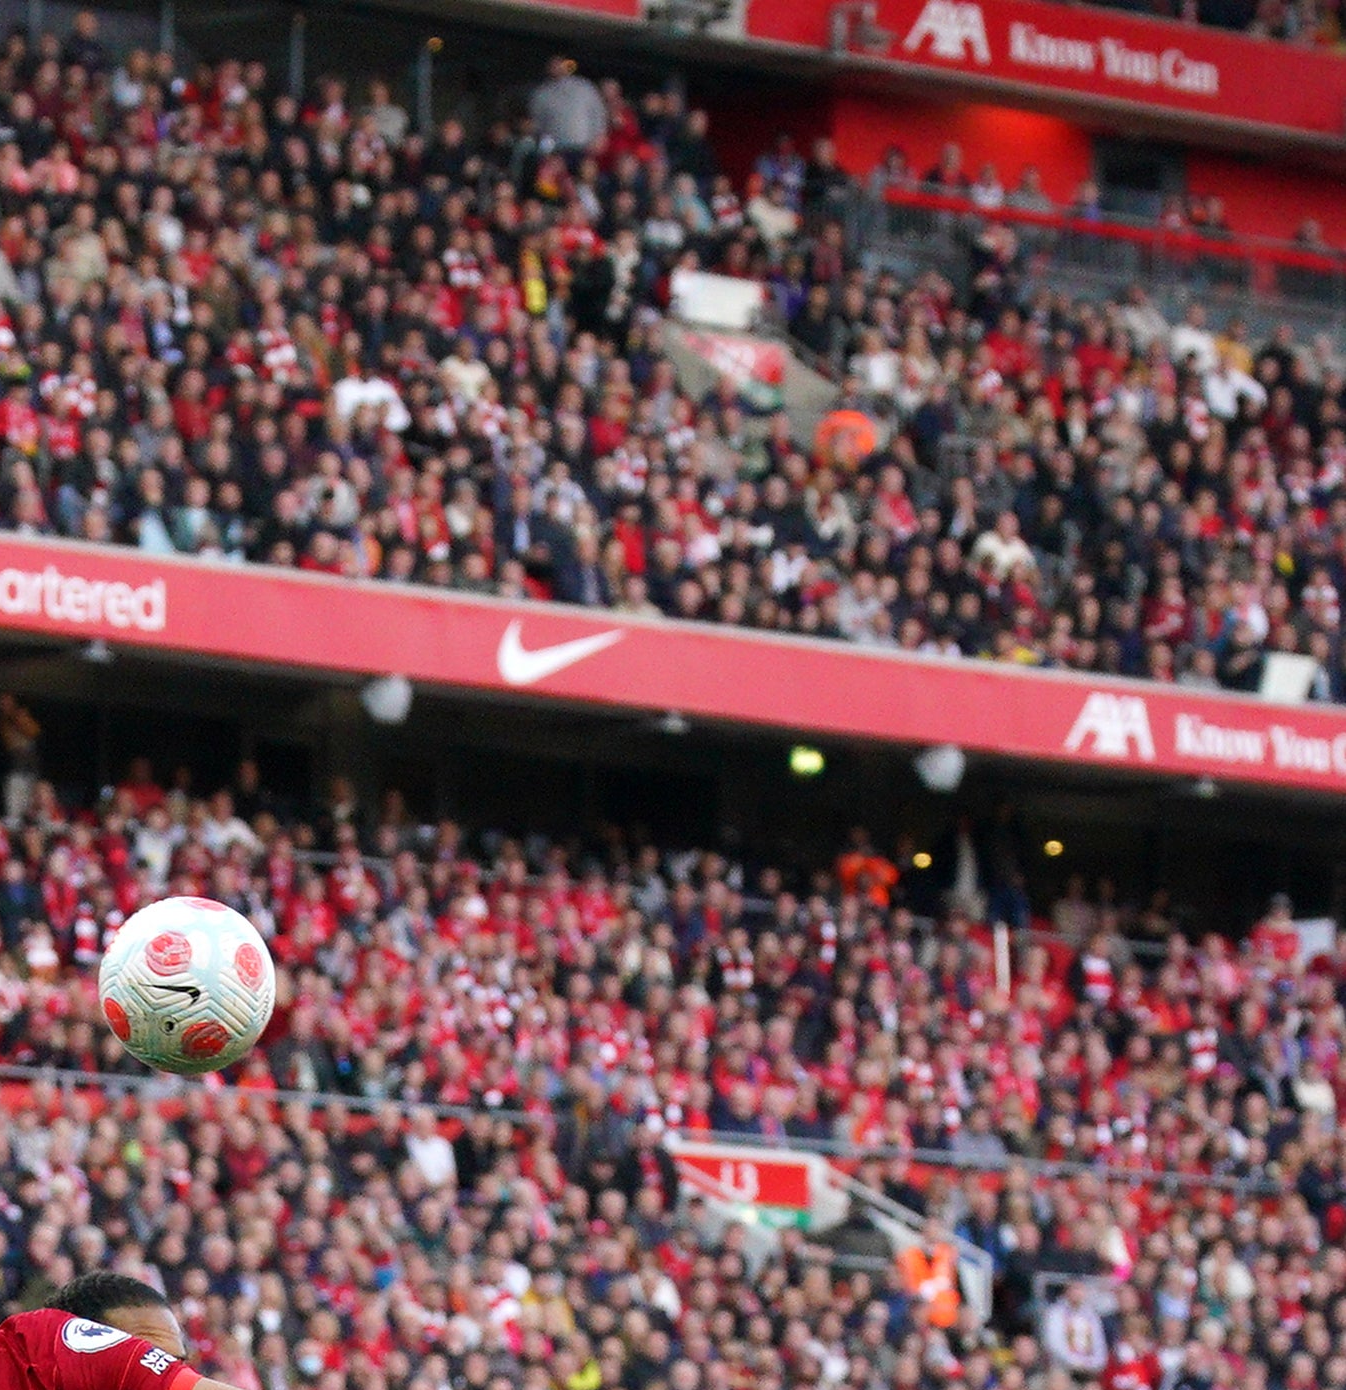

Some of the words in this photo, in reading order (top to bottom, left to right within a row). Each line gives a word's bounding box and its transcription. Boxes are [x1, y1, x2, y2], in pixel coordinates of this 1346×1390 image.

[904, 0, 991, 66] AXA
[1010, 22, 1095, 72] Know
[1100, 37, 1158, 85] You
[1159, 49, 1219, 95] Can
[1063, 691, 1157, 761] AXA
[1175, 713, 1264, 763] Know
[1269, 725, 1331, 773] You
